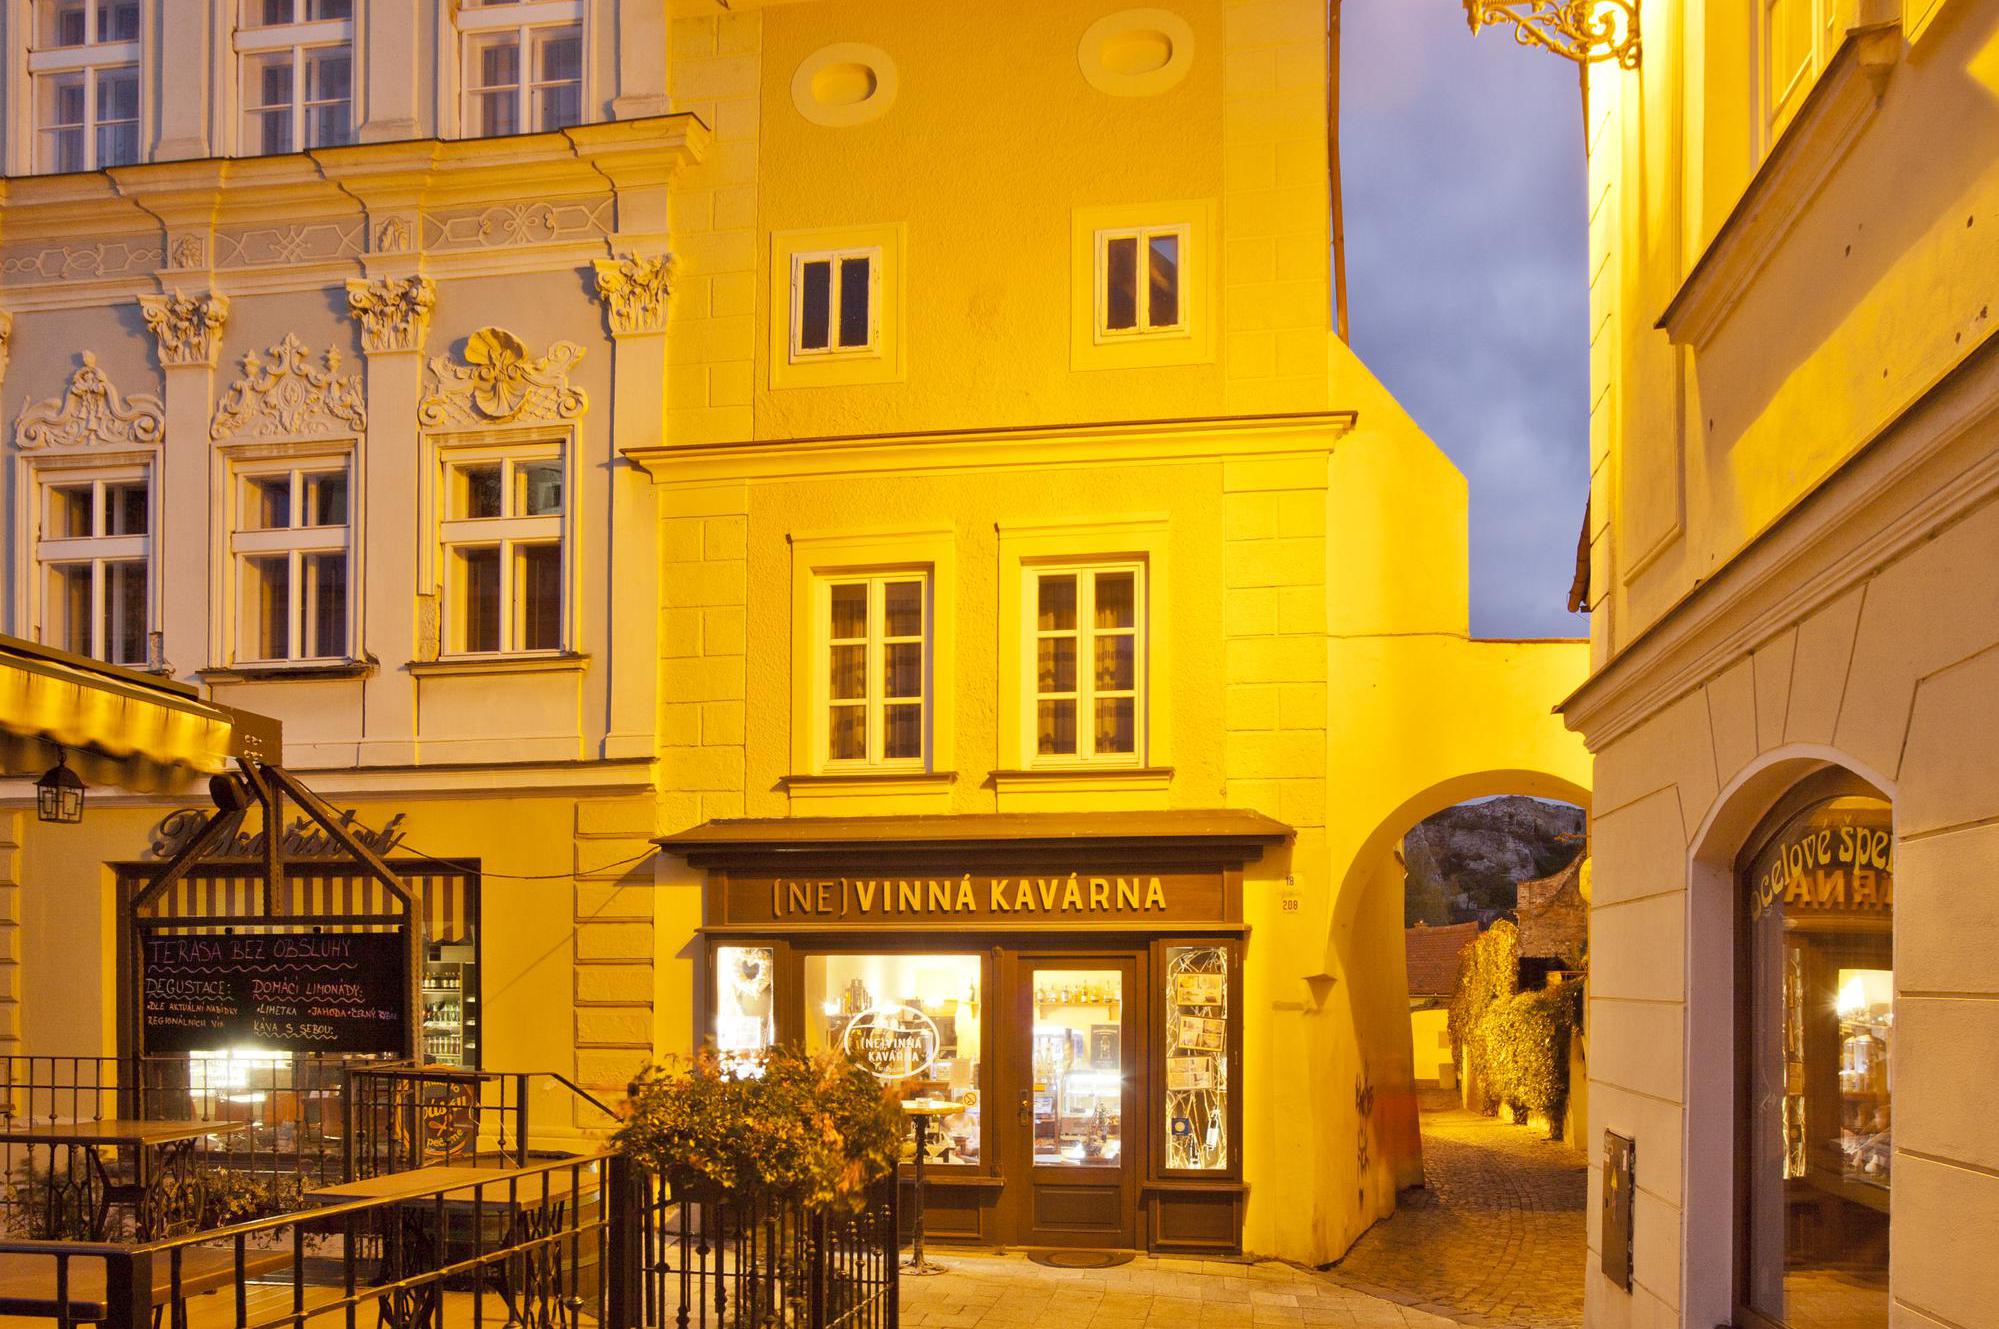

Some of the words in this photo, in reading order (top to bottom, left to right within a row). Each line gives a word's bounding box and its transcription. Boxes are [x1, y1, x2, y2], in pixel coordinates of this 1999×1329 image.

[1839, 814, 1893, 875] špe
[1286, 875, 1294, 886] 18
[772, 872, 977, 916] (NE)VINNÁ
[990, 872, 1168, 912] KAVÁRNA
[1282, 900, 1298, 910] 208
[148, 940, 222, 963] TERASA
[231, 940, 265, 960] BEZ
[273, 938, 350, 958] OBSLUHY
[145, 978, 231, 995] DEGUSTACE:
[252, 976, 299, 995] DOMÁCÍ
[254, 1017, 278, 1031] KÁVA
[286, 1024, 294, 1033] S
